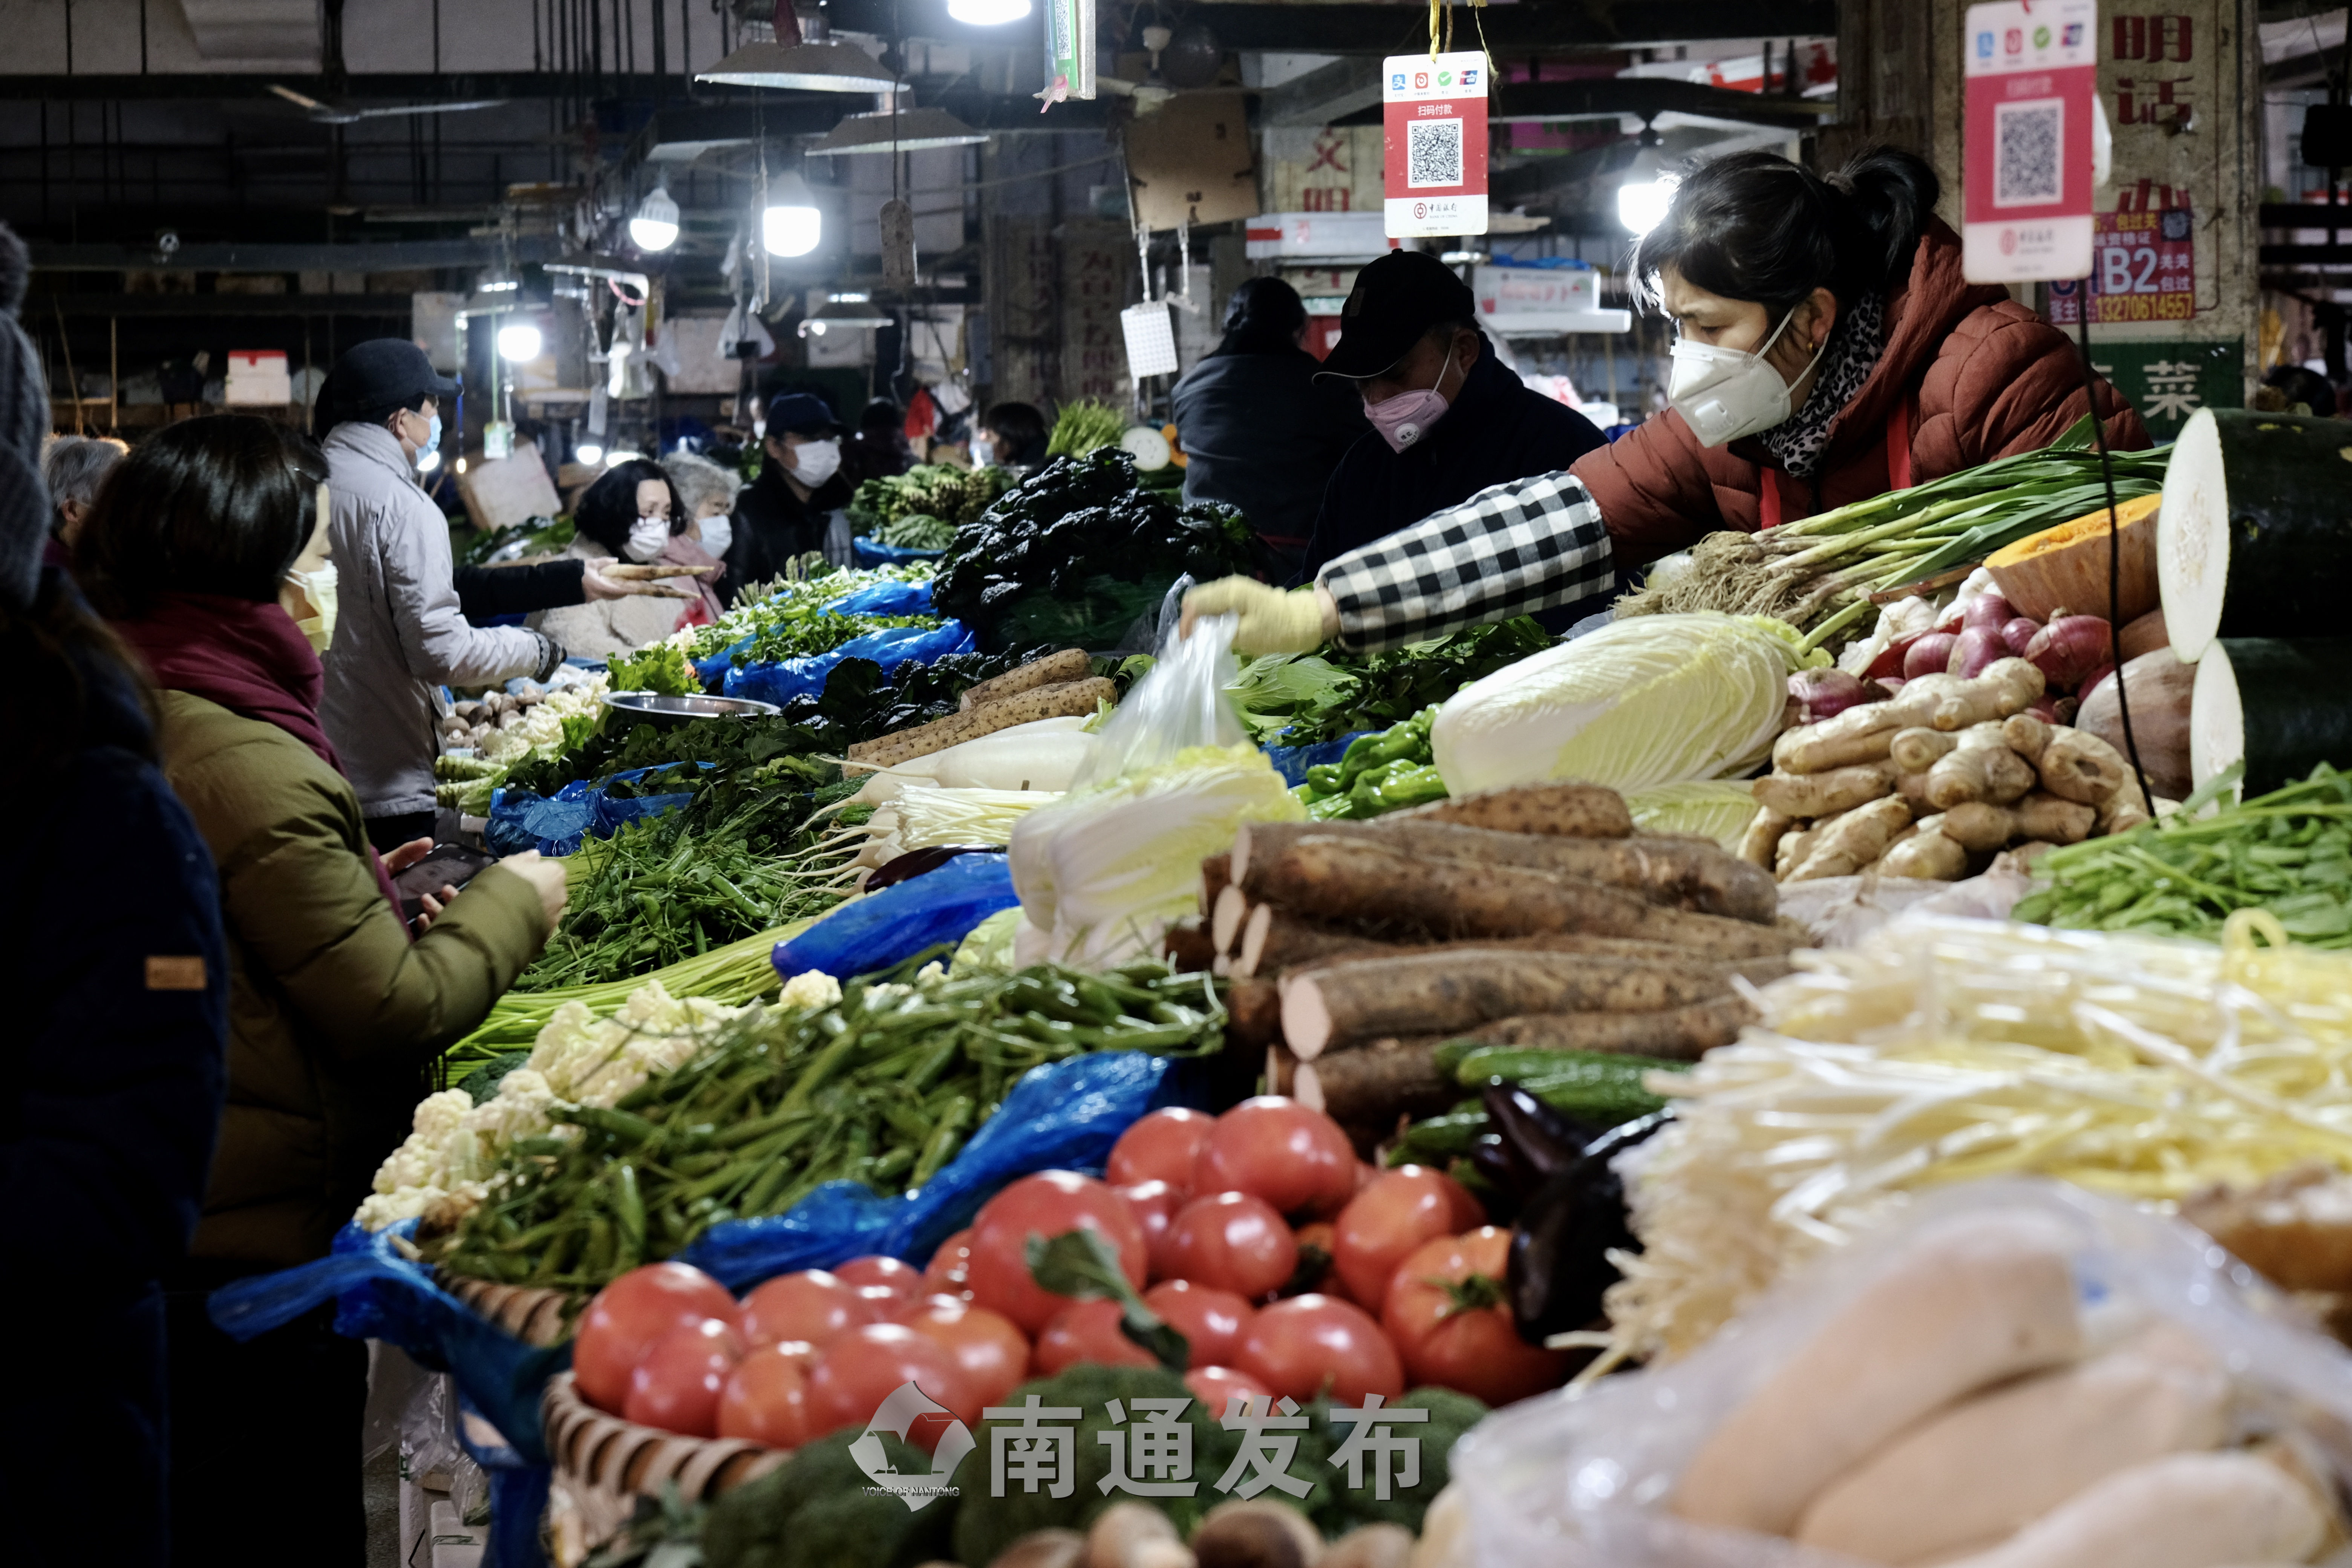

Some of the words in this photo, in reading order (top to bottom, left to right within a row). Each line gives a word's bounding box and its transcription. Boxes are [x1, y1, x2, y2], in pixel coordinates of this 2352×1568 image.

[1418, 104, 1452, 116] 扫码付款
[2103, 247, 2159, 294] B2
[2096, 292, 2193, 322] 13270614557
